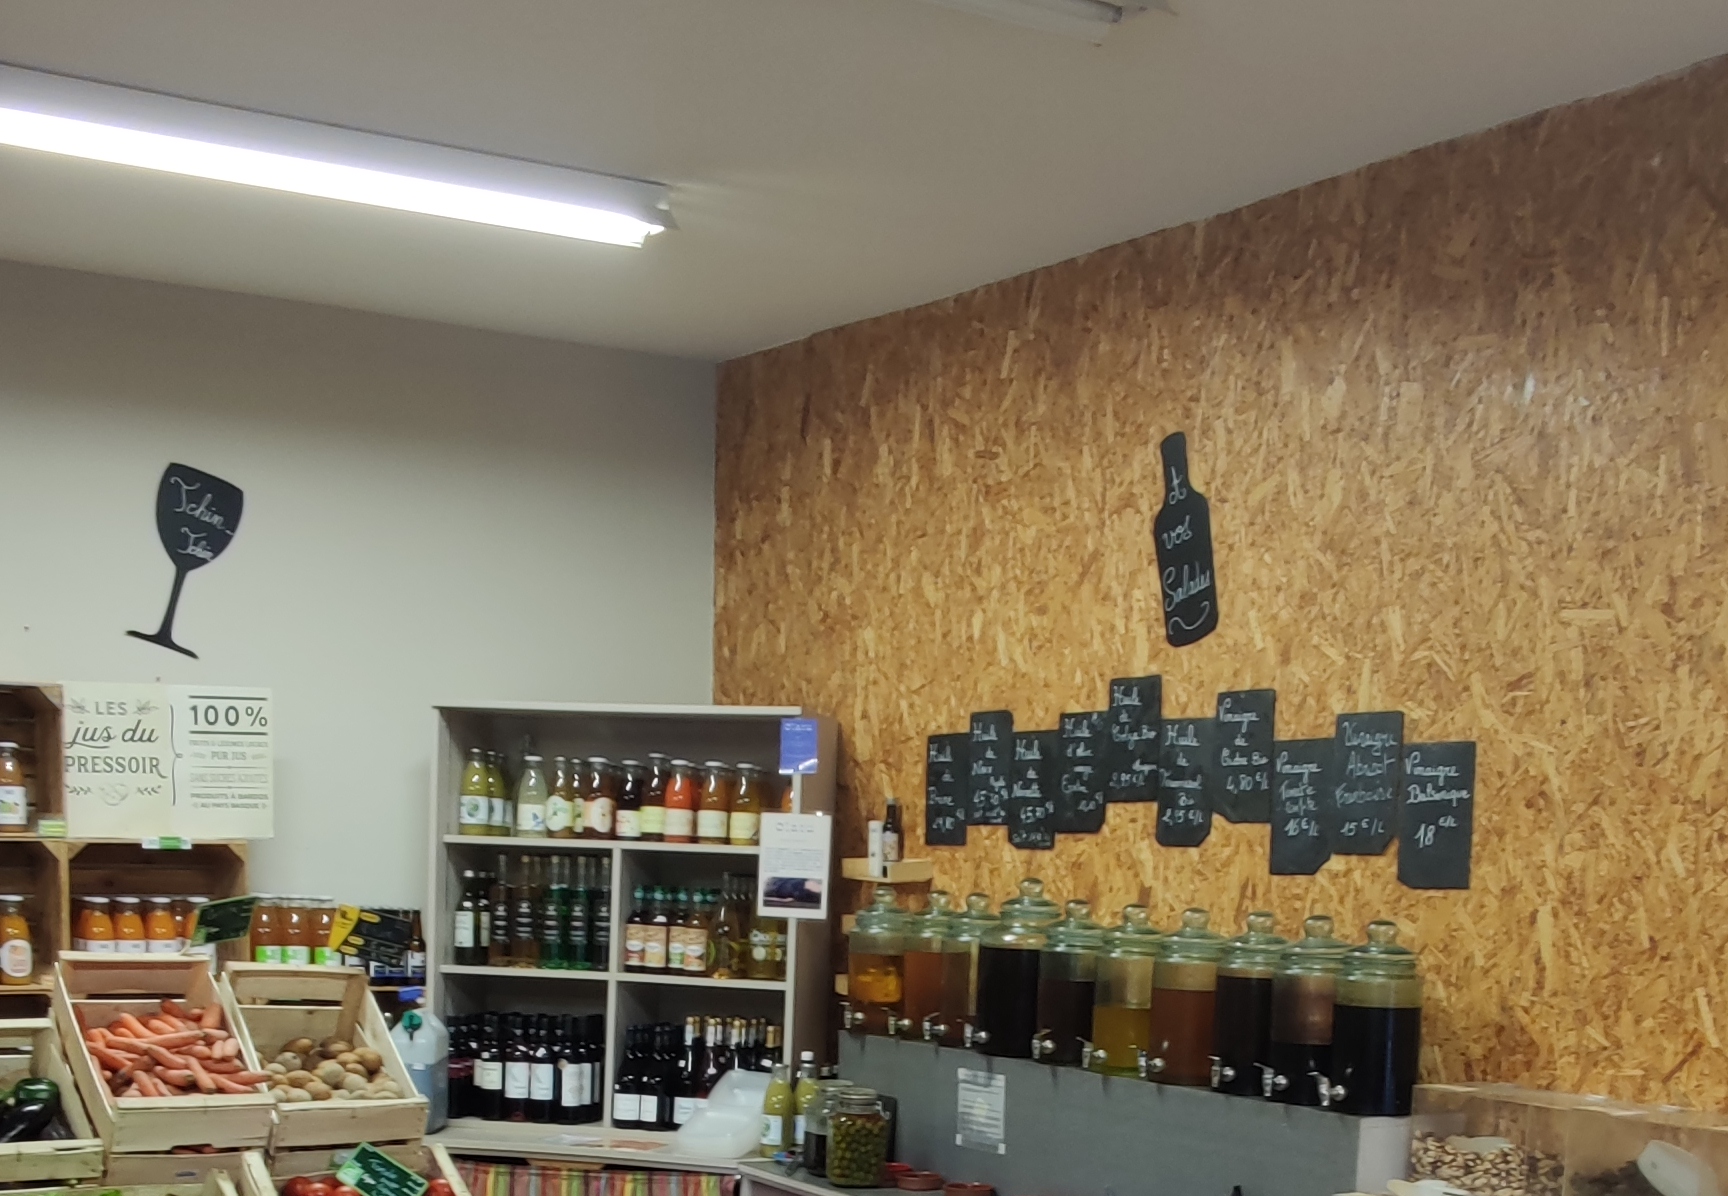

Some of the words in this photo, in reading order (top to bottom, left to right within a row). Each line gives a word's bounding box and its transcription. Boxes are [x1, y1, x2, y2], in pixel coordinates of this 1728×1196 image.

[1162, 515, 1193, 549] vos
[95, 701, 128, 715] LES
[189, 704, 268, 727] 100%
[64, 721, 116, 749] jus
[122, 719, 159, 743] du
[211, 751, 229, 760] PUR
[231, 751, 247, 760] JUS
[64, 756, 168, 779] PRESSOIR
